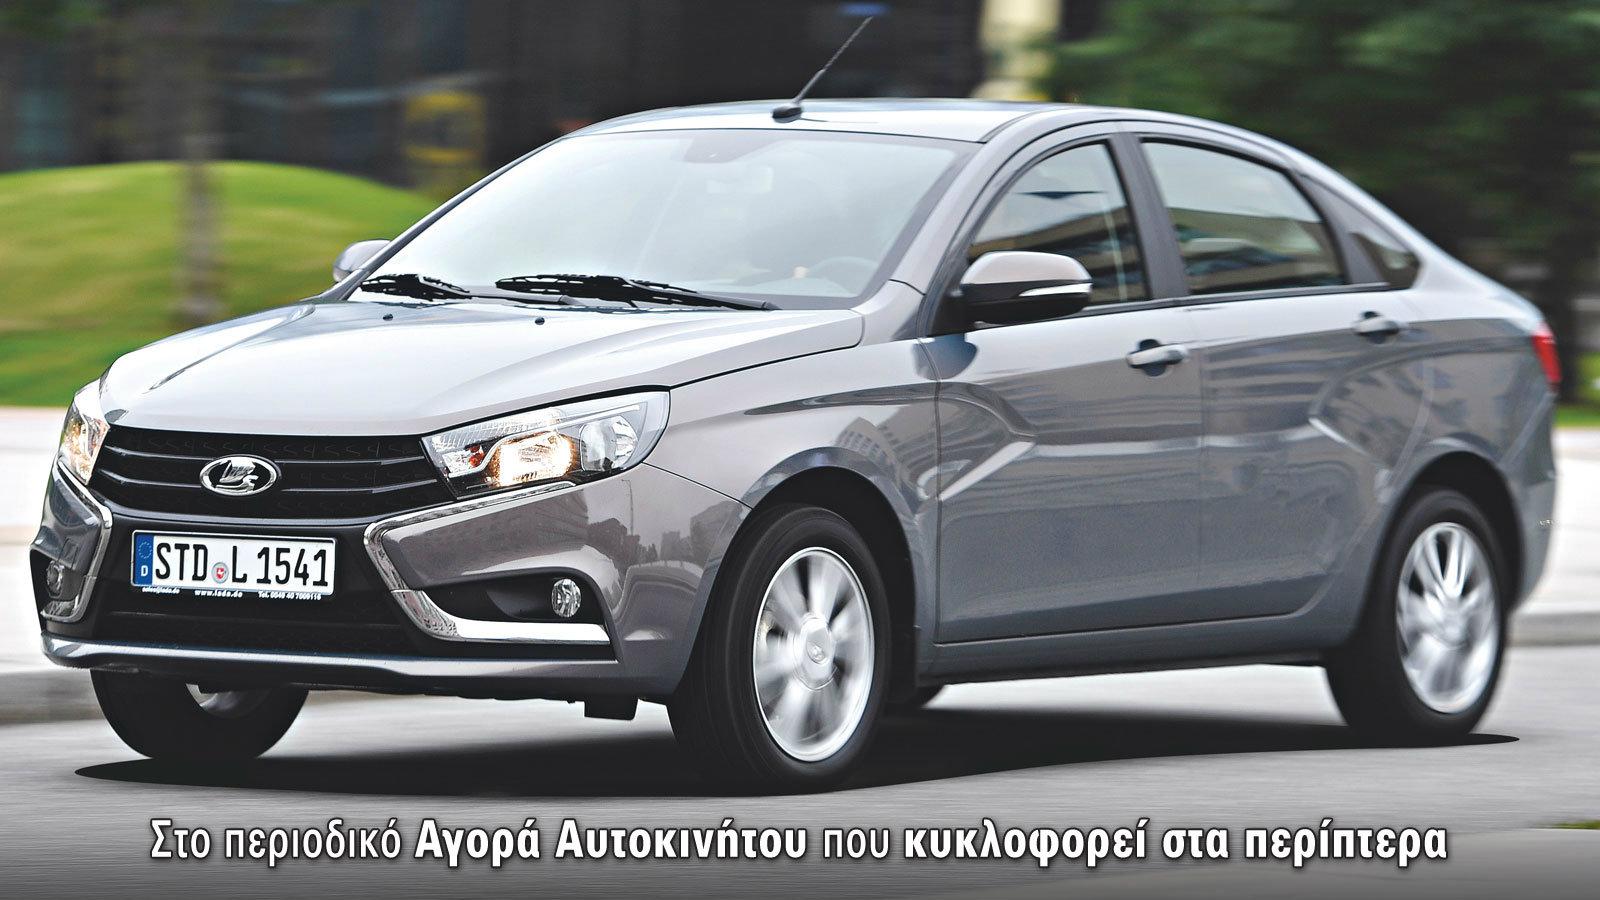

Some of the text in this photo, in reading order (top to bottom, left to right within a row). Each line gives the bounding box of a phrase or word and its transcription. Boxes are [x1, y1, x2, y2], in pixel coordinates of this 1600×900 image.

[155, 542, 329, 587] STD L 1541
[140, 565, 149, 577] D
[194, 589, 243, 599] www.lada.de
